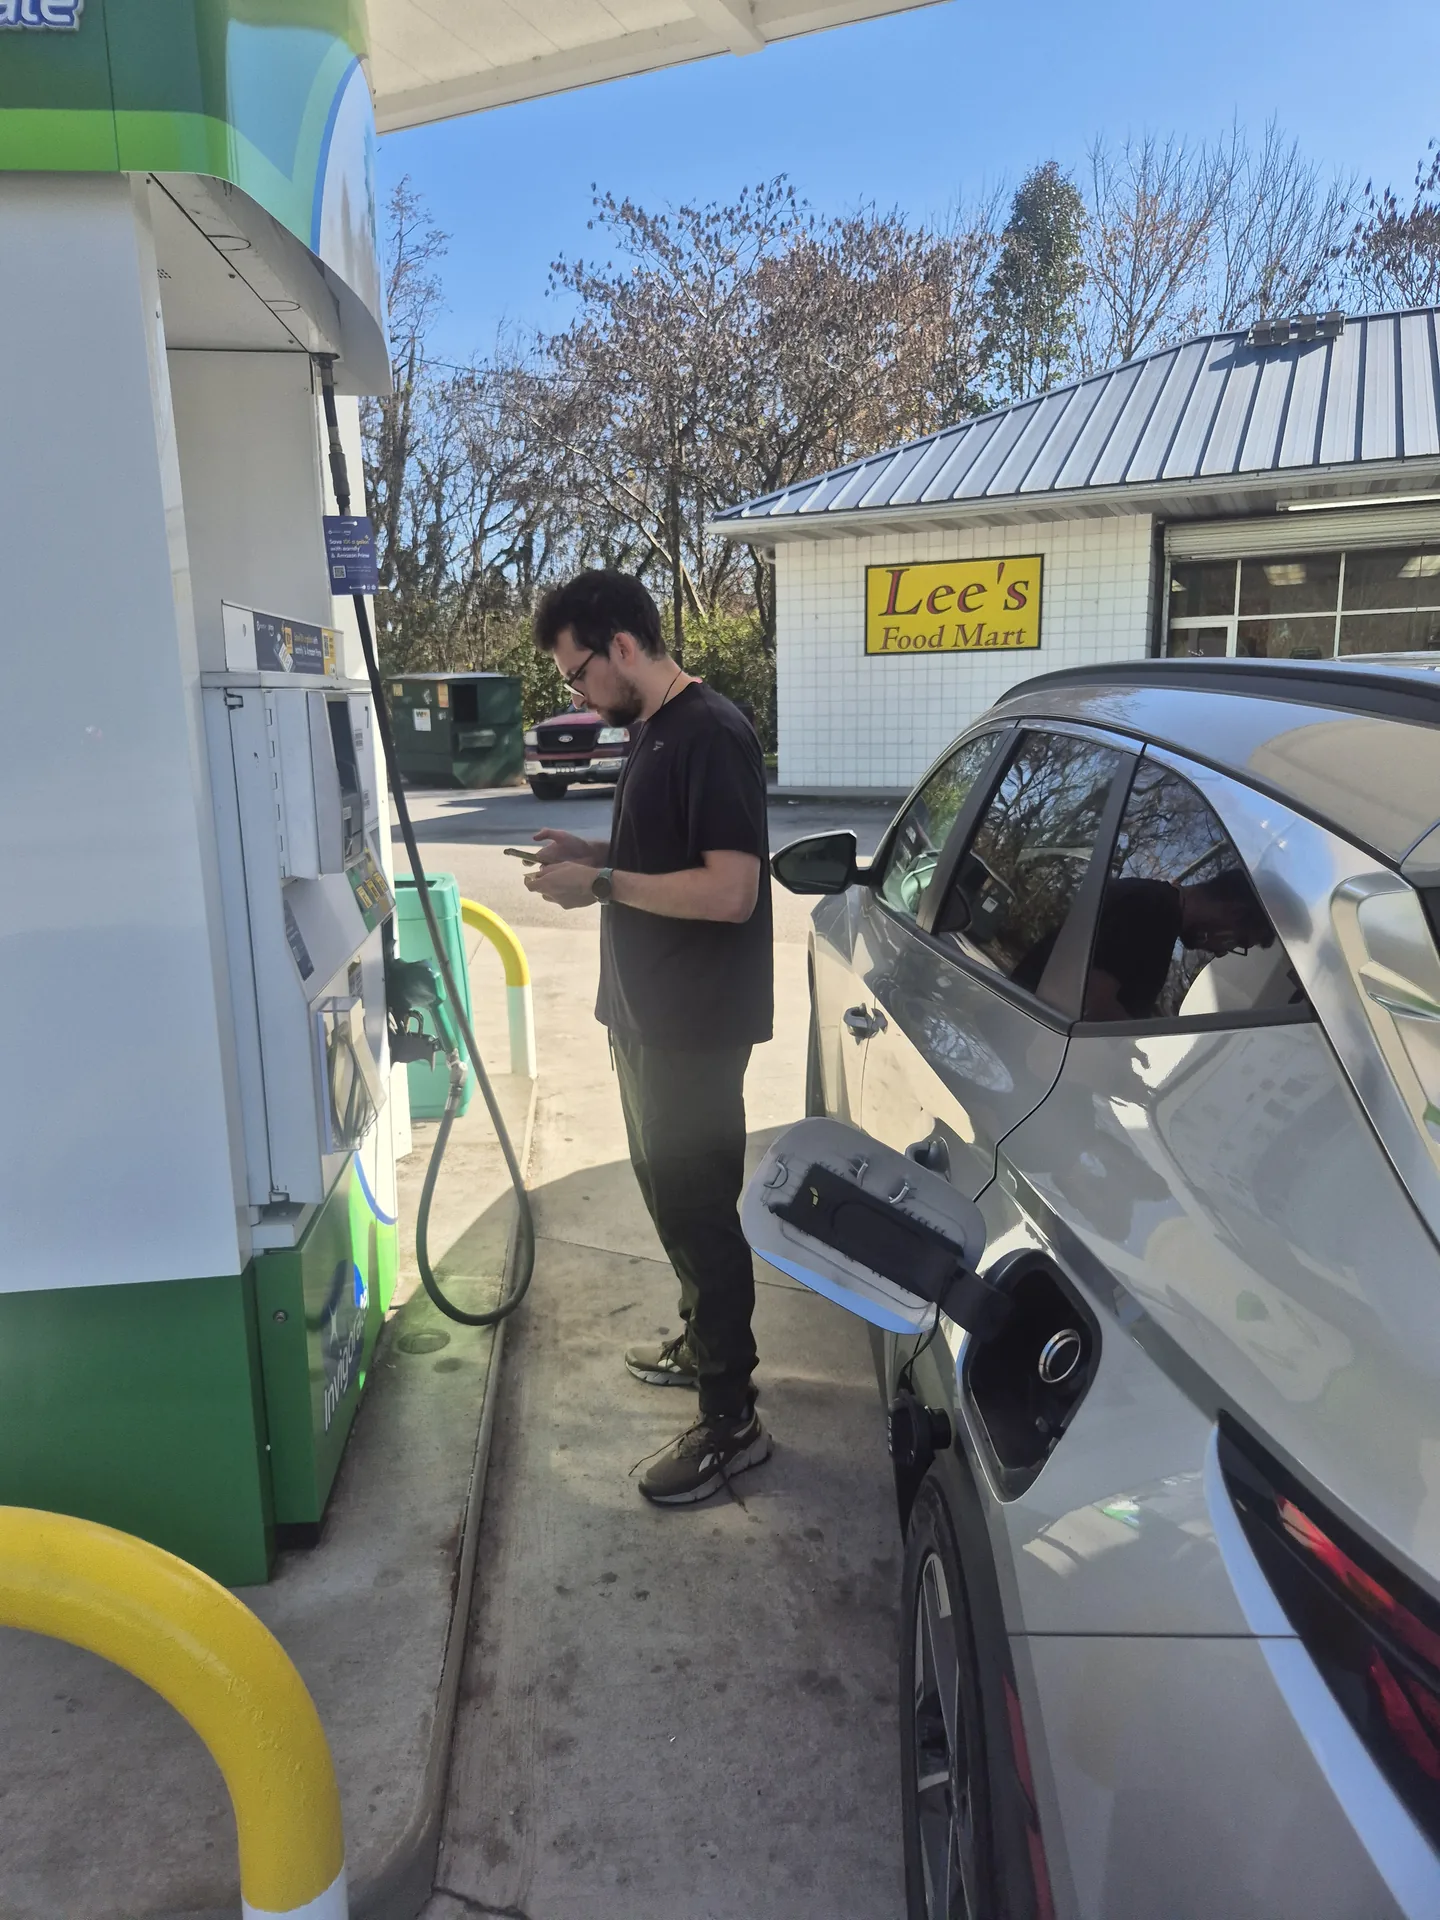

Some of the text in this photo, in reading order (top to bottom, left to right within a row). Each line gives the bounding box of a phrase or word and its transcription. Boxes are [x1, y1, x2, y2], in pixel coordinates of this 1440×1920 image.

[878, 562, 1029, 616] Lee's
[879, 622, 1027, 650] Food Mart
